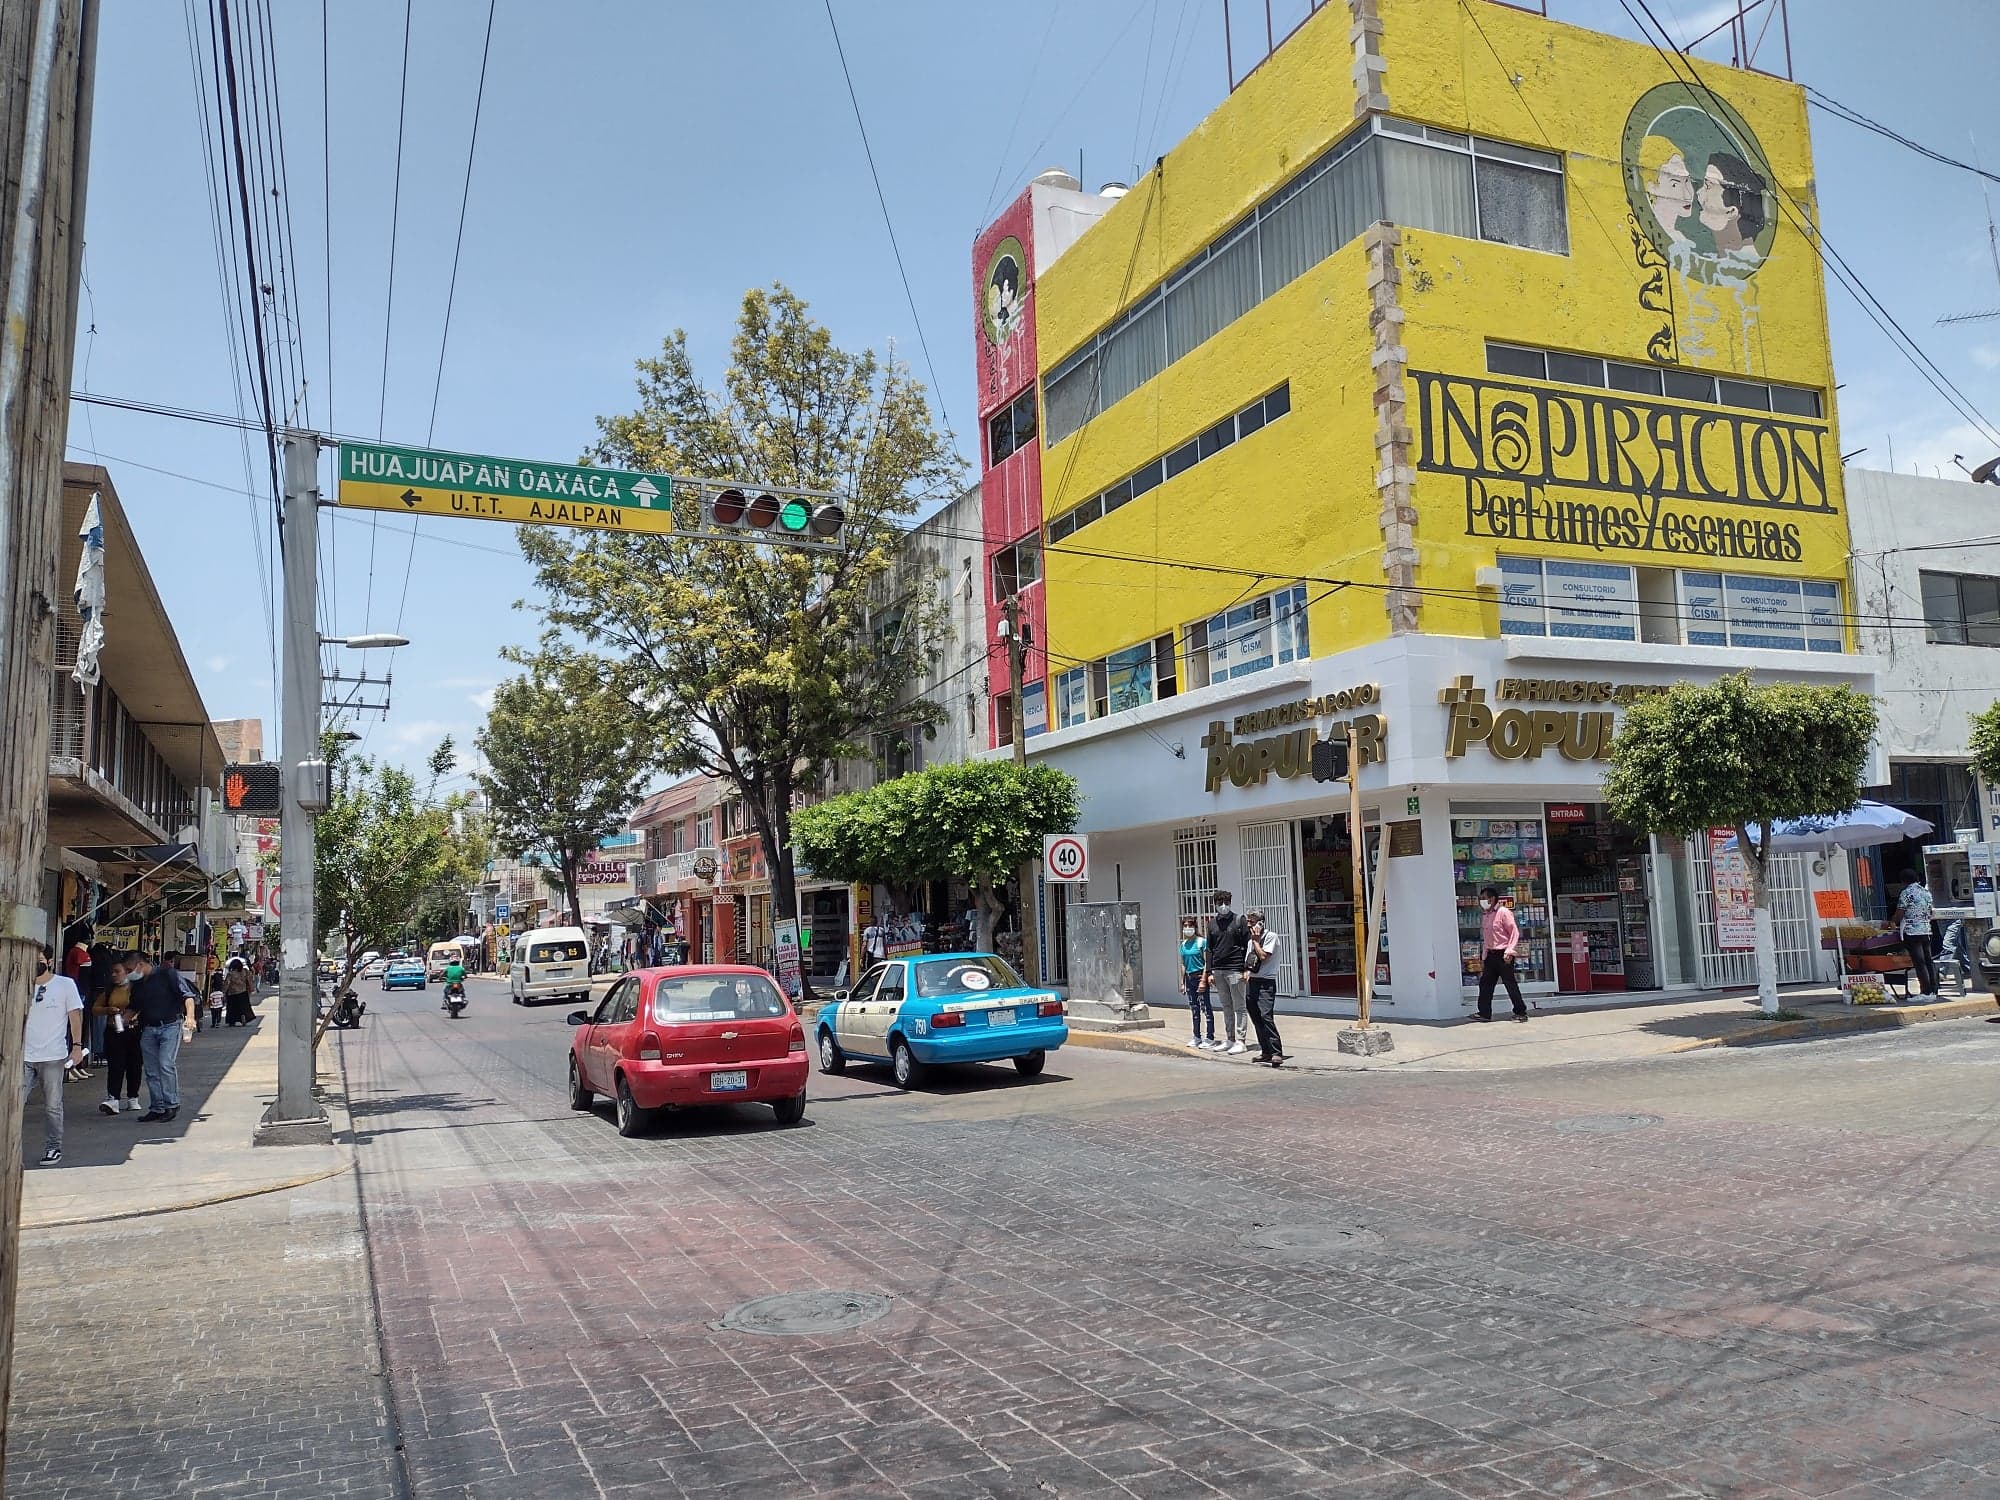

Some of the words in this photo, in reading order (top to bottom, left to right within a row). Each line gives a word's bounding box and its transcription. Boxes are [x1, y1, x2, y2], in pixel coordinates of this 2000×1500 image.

[351, 450, 510, 489] HUAJUAPAN
[519, 469, 621, 500] OAXACA
[450, 493, 504, 515] U.T.T.
[529, 502, 622, 525] AJALPAN
[1562, 583, 1616, 594] CONSULTORIO
[1509, 595, 1537, 607] CISM
[1741, 596, 1788, 607] CONSULTORIO
[1694, 608, 1719, 620] CISM
[1242, 640, 1262, 654] CISM
[1496, 678, 1614, 703] FARMACIAS
[1233, 698, 1314, 737] FARMACIAS
[1314, 683, 1381, 716] APOYO
[1445, 702, 1616, 761] POPUL
[1550, 810, 1584, 819] ENTRADA
[1058, 848, 1077, 866] 40
[1847, 975, 1877, 983] PELOTAS
[914, 1018, 927, 1036] 750
